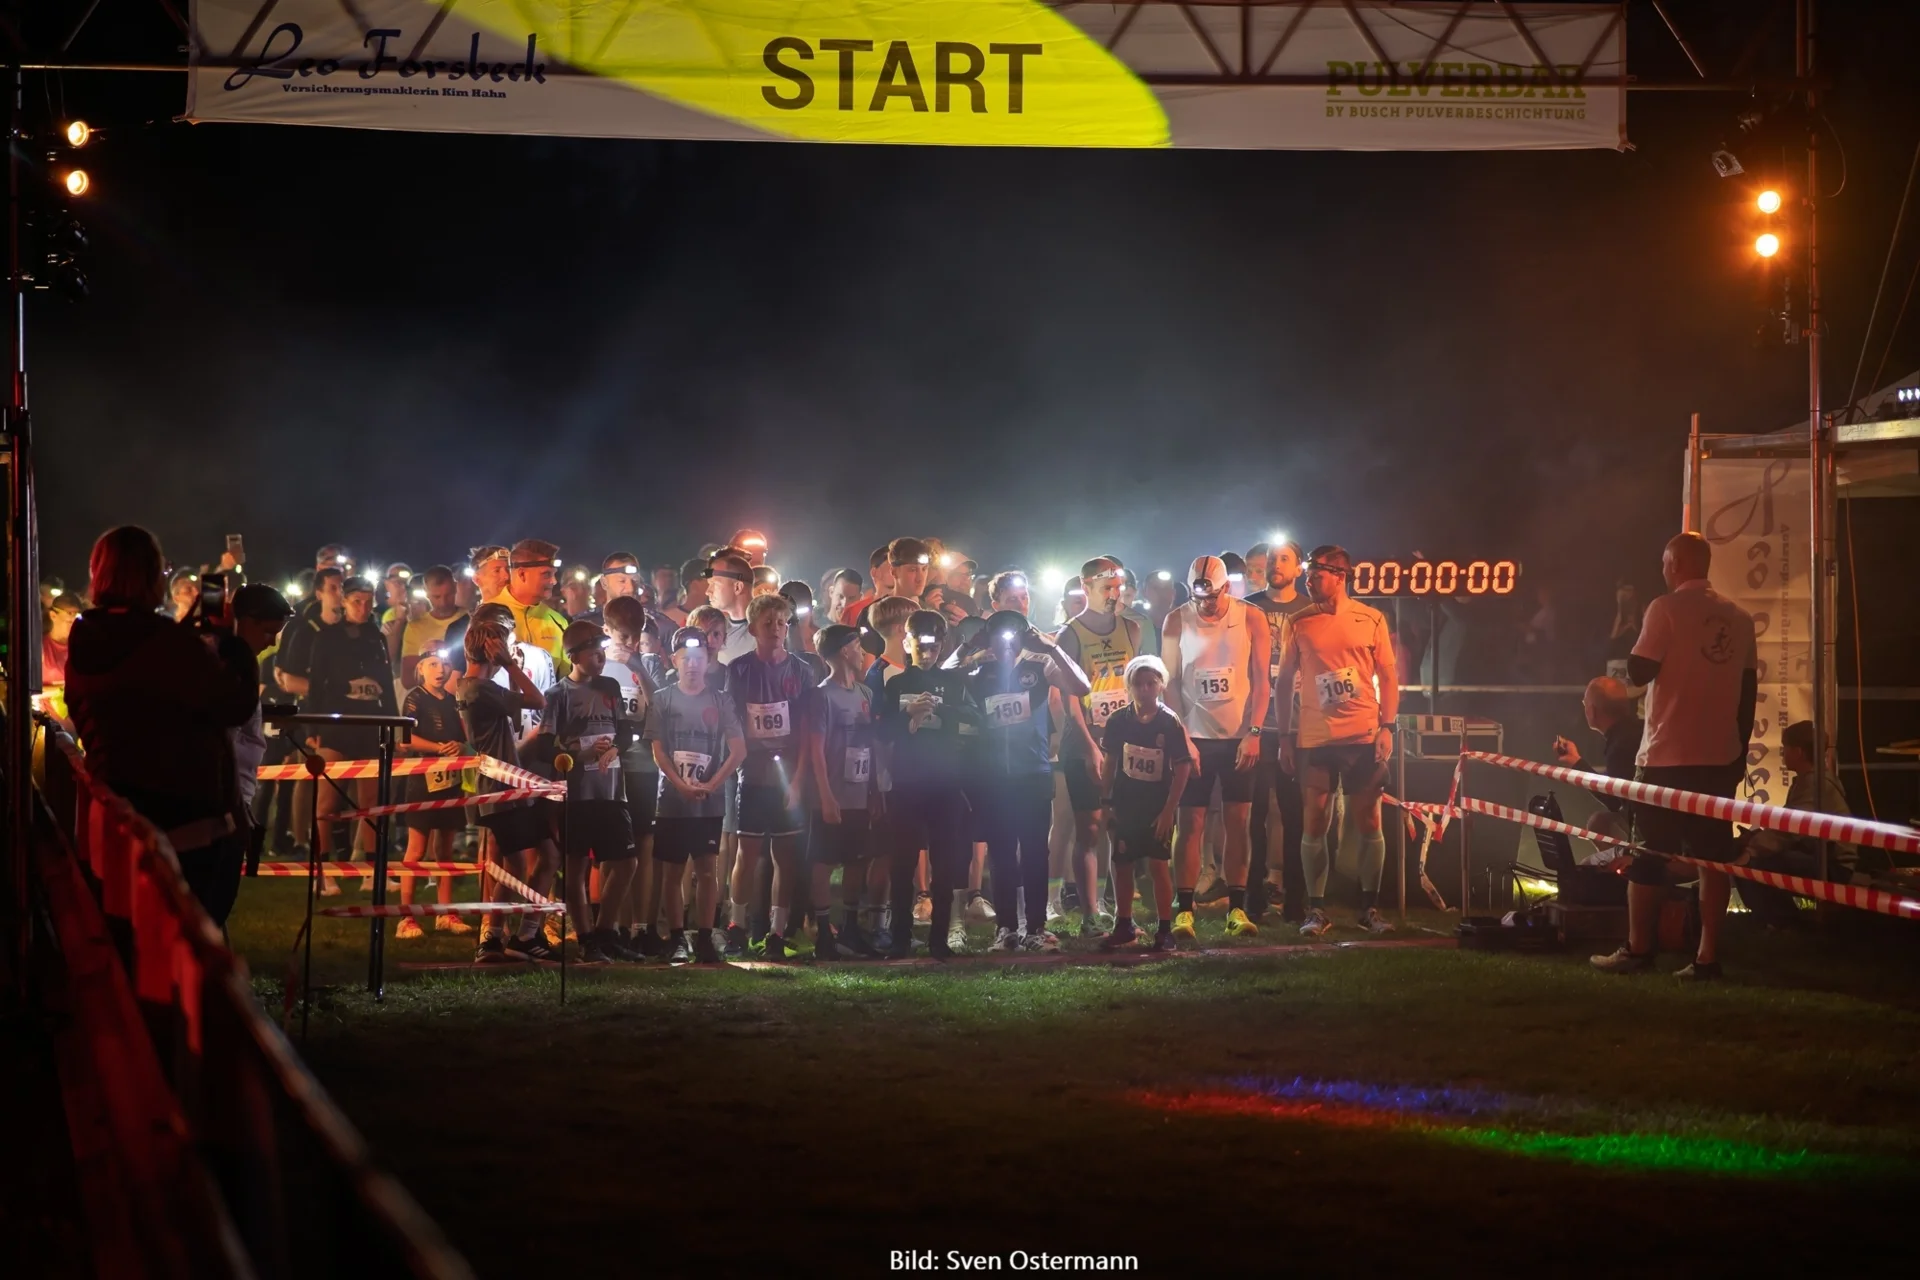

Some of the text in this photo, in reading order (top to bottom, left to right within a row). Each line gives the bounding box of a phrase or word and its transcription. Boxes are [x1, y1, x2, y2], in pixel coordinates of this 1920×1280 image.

[223, 23, 547, 91] Leo Forsbeck
[761, 36, 1043, 115] START
[1325, 61, 1586, 99] PULVERBAR
[282, 83, 507, 99] Versicherungsmaklerin Kim Hahn
[1325, 106, 1586, 120] BY BUSCH PULVERBESCHICHTUNG
[1200, 678, 1230, 694] 153
[1324, 678, 1354, 697] 106
[993, 700, 1023, 720] 150
[754, 713, 783, 730] 169
[679, 762, 705, 780] 176
[1127, 755, 1155, 774] 148
